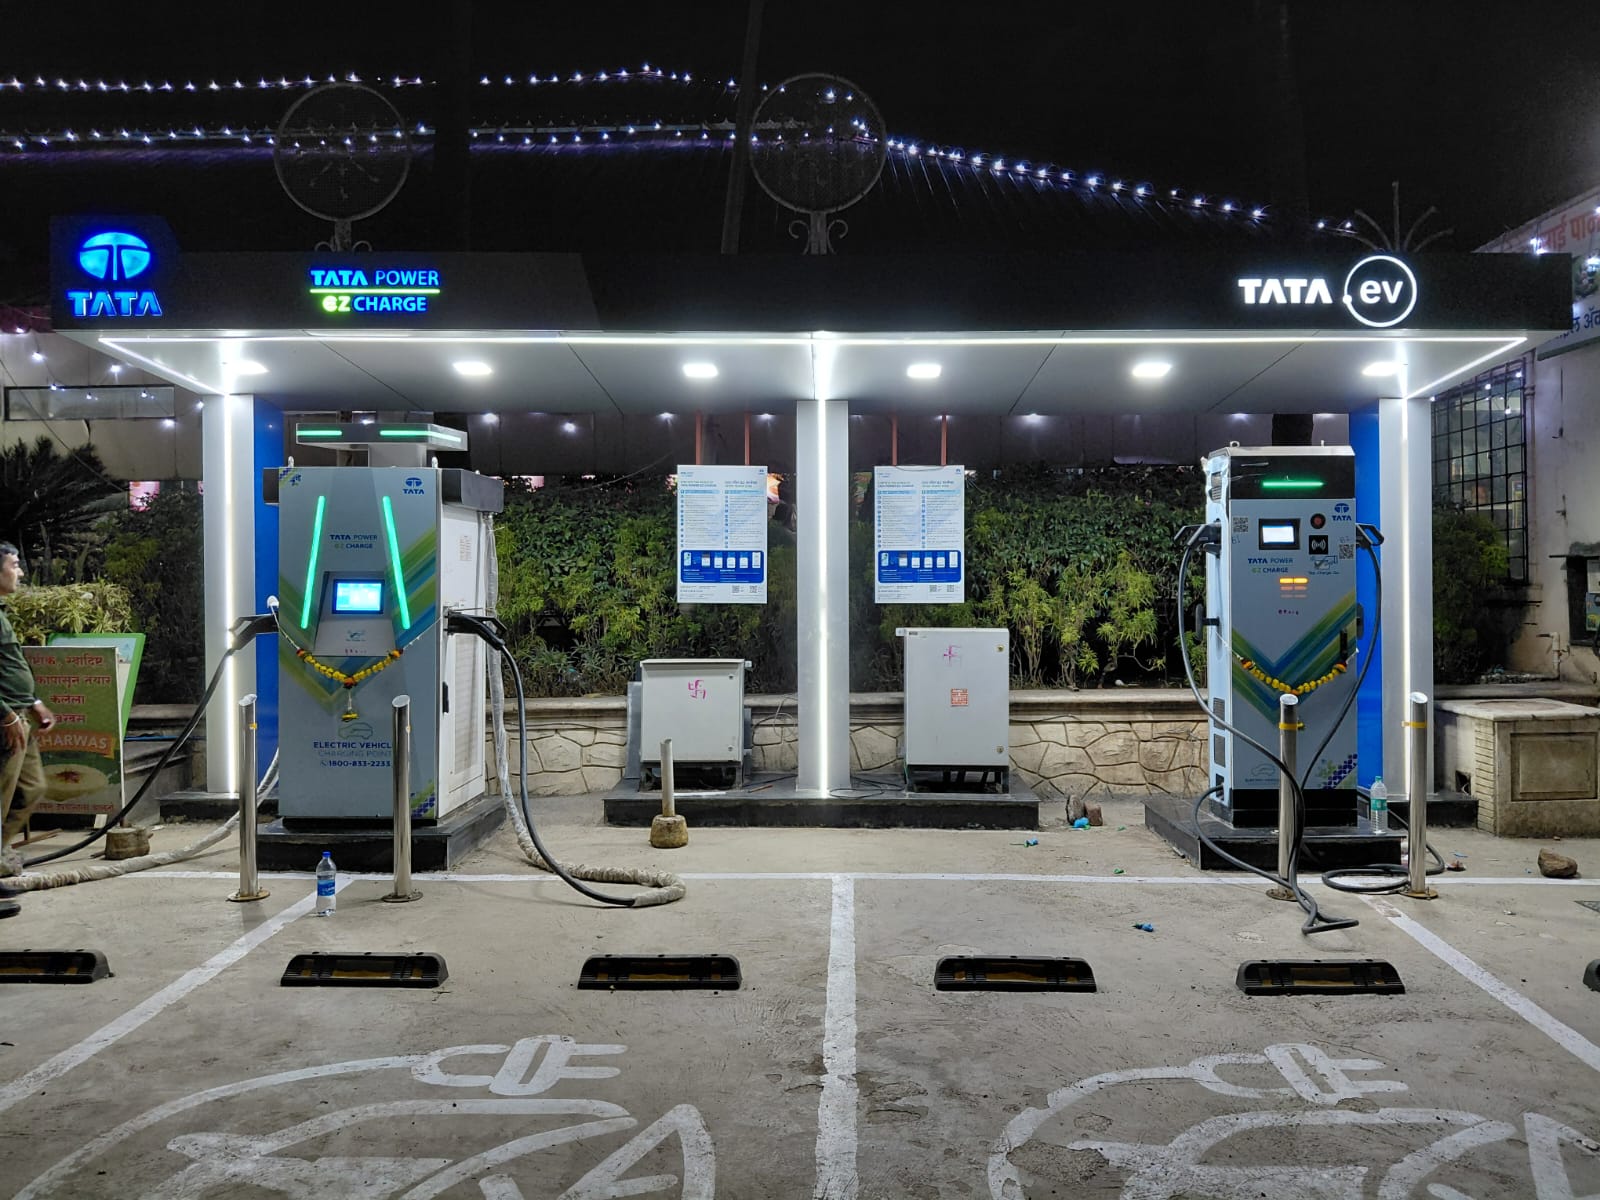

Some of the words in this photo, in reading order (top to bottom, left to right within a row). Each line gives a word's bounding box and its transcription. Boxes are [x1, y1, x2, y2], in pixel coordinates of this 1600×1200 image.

[310, 270, 368, 286] TATA
[375, 270, 439, 286] POWER
[1238, 278, 1333, 304] TATA
[1360, 280, 1403, 304] ev
[67, 291, 162, 316] TATA
[353, 296, 427, 311] CHARGE
